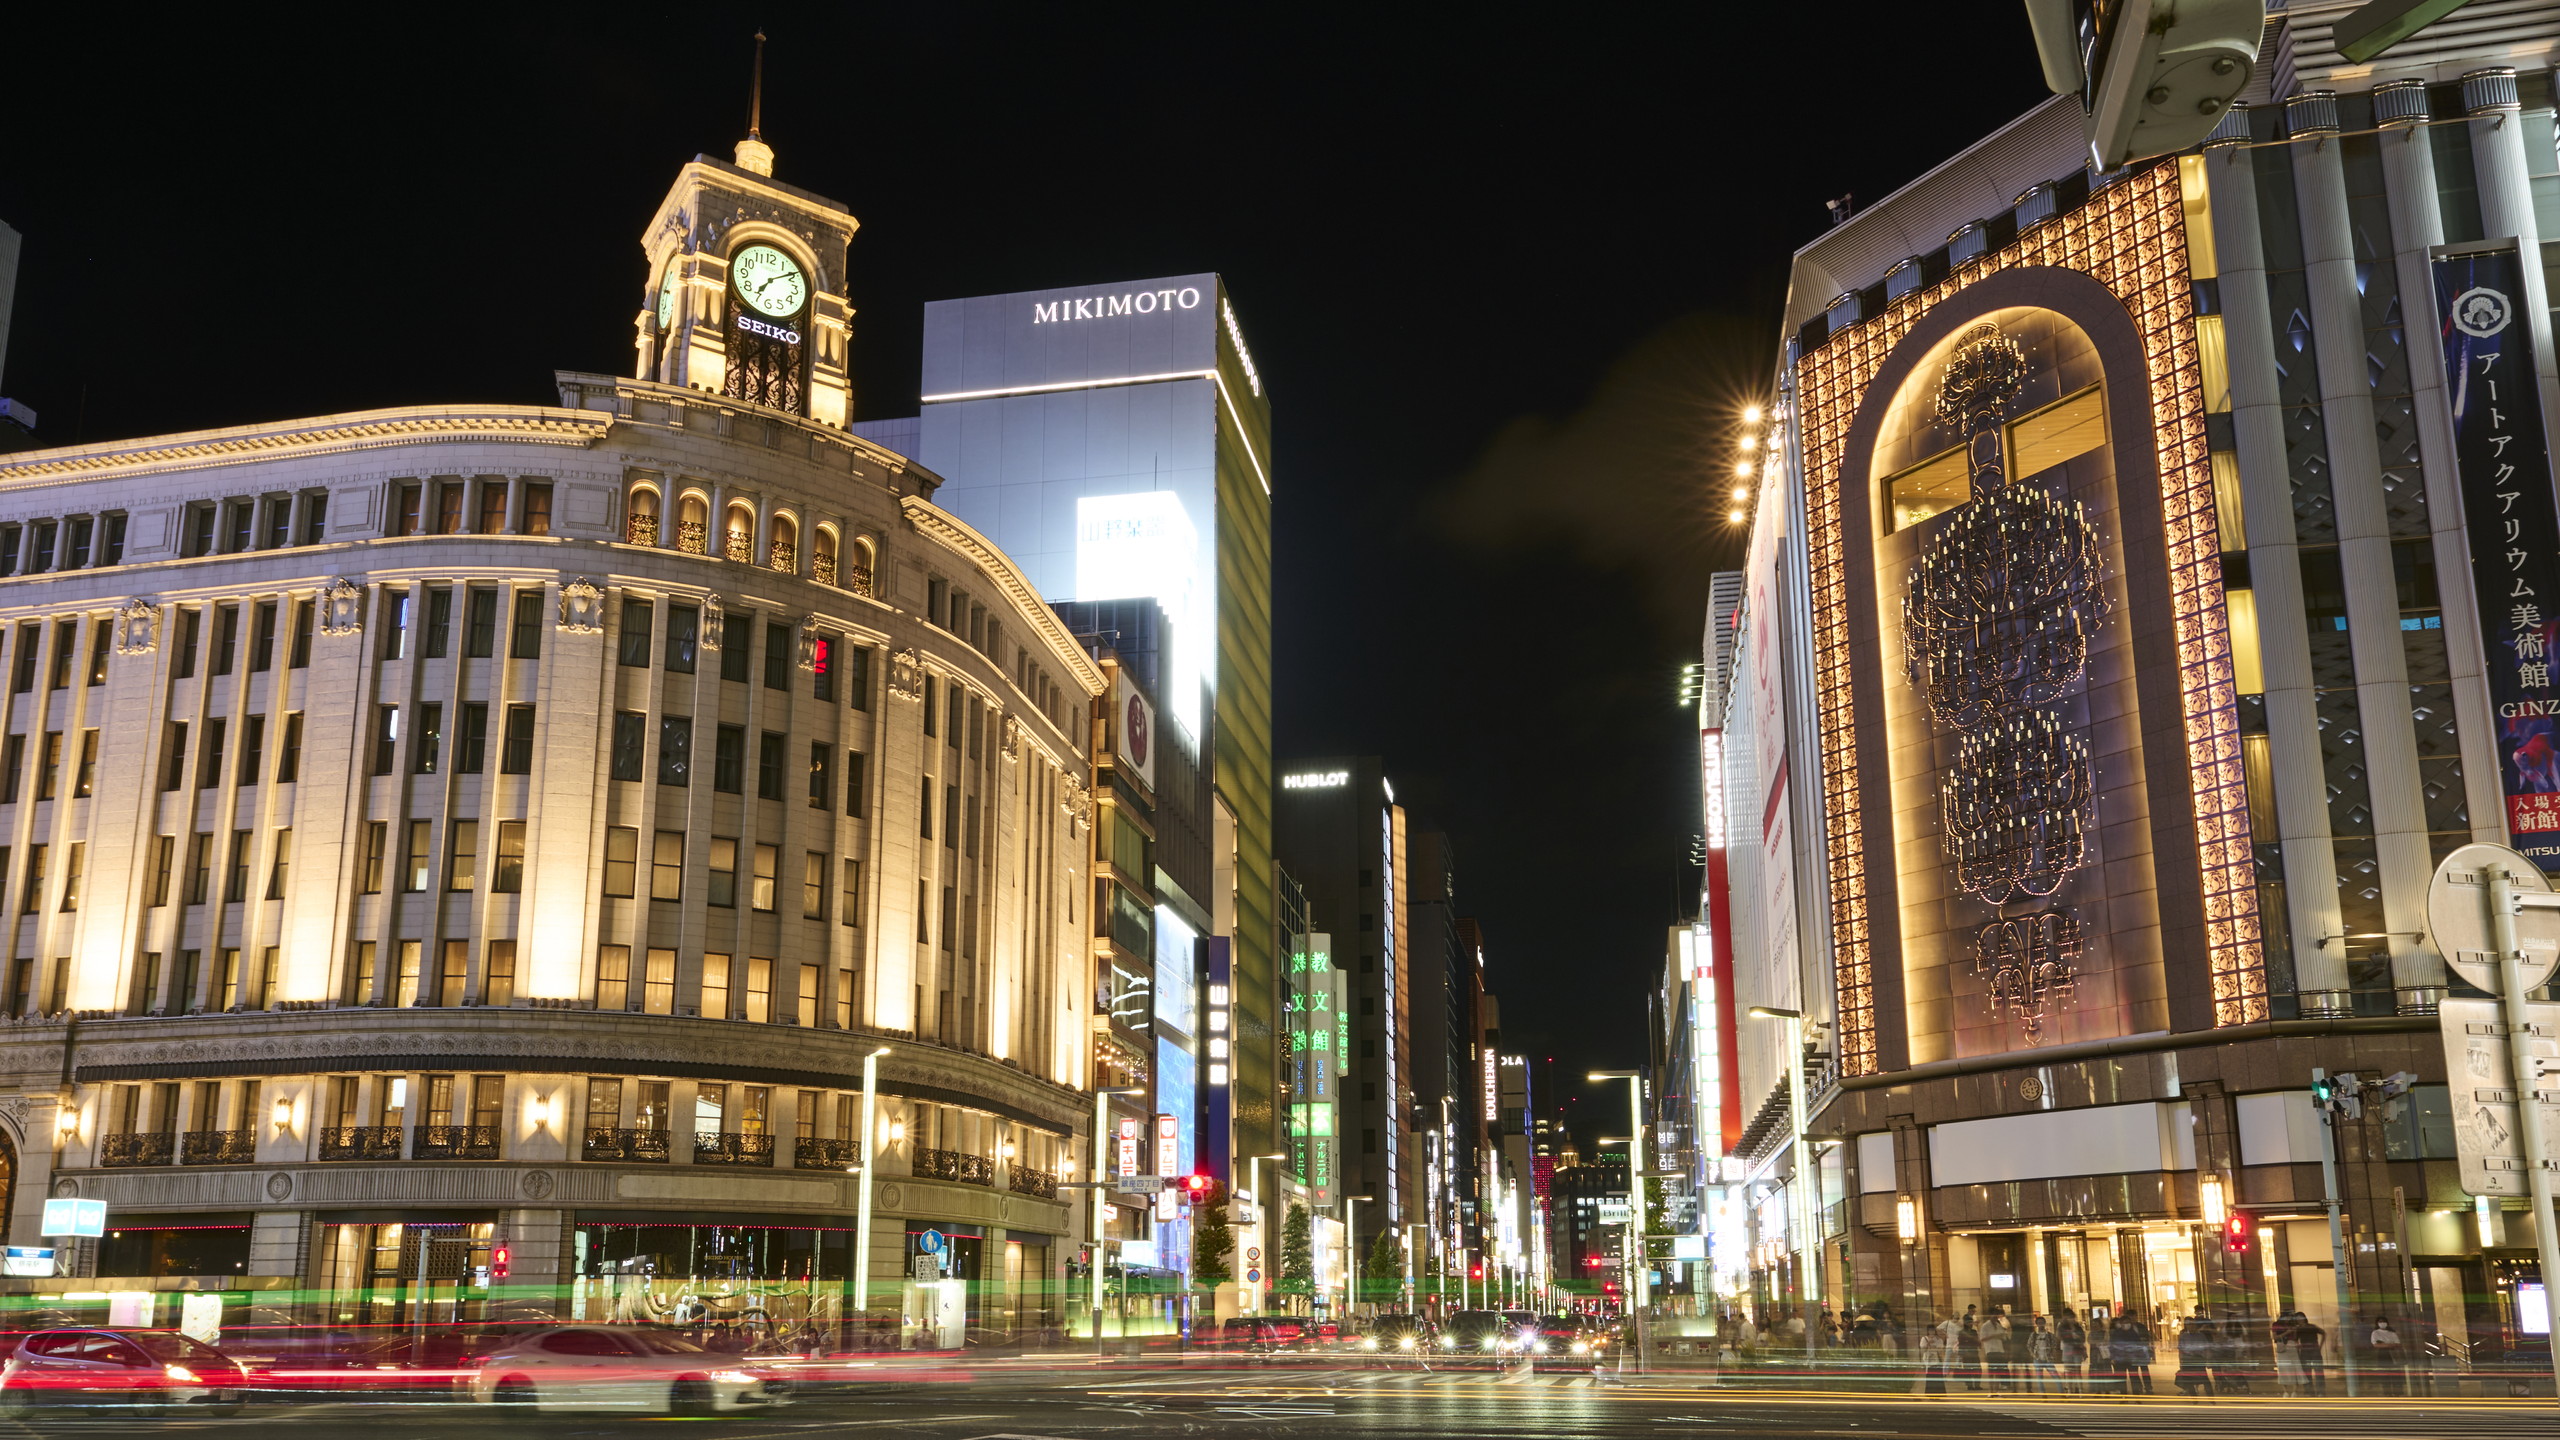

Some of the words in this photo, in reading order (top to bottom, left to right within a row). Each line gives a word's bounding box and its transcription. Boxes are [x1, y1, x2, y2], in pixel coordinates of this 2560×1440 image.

[745, 258, 755, 269] 10
[756, 252, 763, 264] 11
[766, 253, 777, 265] 12
[740, 268, 749, 279] 9
[743, 280, 752, 292] 8
[790, 284, 799, 295] 3
[754, 291, 762, 303] 7
[785, 295, 794, 305] 4
[763, 298, 772, 310] 6
[776, 299, 784, 310] 5
[1033, 287, 1200, 324] MIKIMOTO
[737, 316, 800, 345] SEIKO
[1222, 297, 1259, 398] MIKIMOTO
[2476, 352, 2550, 689] アートアクアリウム美術館
[1284, 771, 1348, 789] HUBLOT
[1703, 734, 1725, 849] MITSUKOSHI
[1310, 951, 1329, 1051] 教文館
[1338, 1011, 1348, 1069] 教文館ビル
[1484, 1048, 1497, 1120] BOUCHERON
[1316, 1141, 1327, 1186] ナルニア国
[1121, 1179, 1160, 1188] 銀座四丁目
